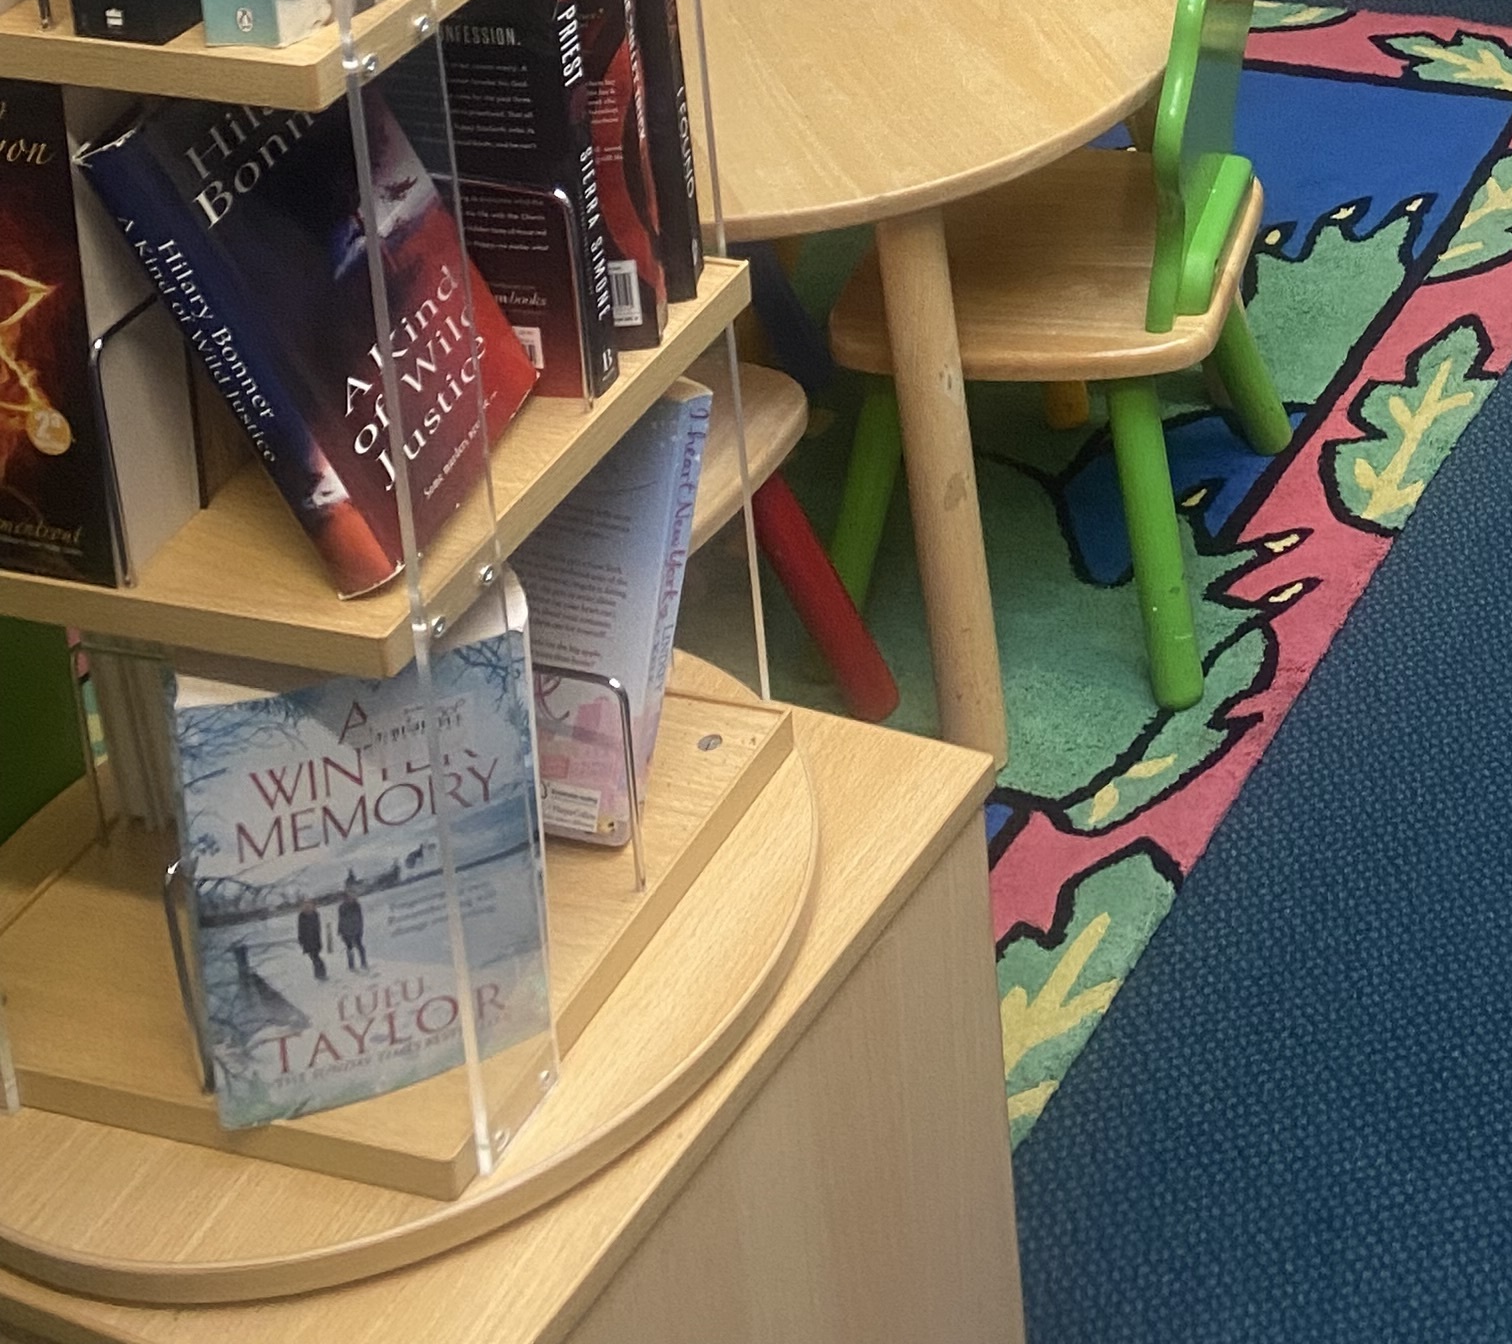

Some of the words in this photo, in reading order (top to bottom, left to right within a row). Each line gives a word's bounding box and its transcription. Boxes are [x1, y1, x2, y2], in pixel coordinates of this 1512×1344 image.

[555, 4, 584, 88] PRIEST
[156, 239, 215, 322] Hilary
[209, 326, 277, 422] Bonner
[235, 757, 499, 864] MEMORY
[276, 983, 505, 1073] TAYLOR
